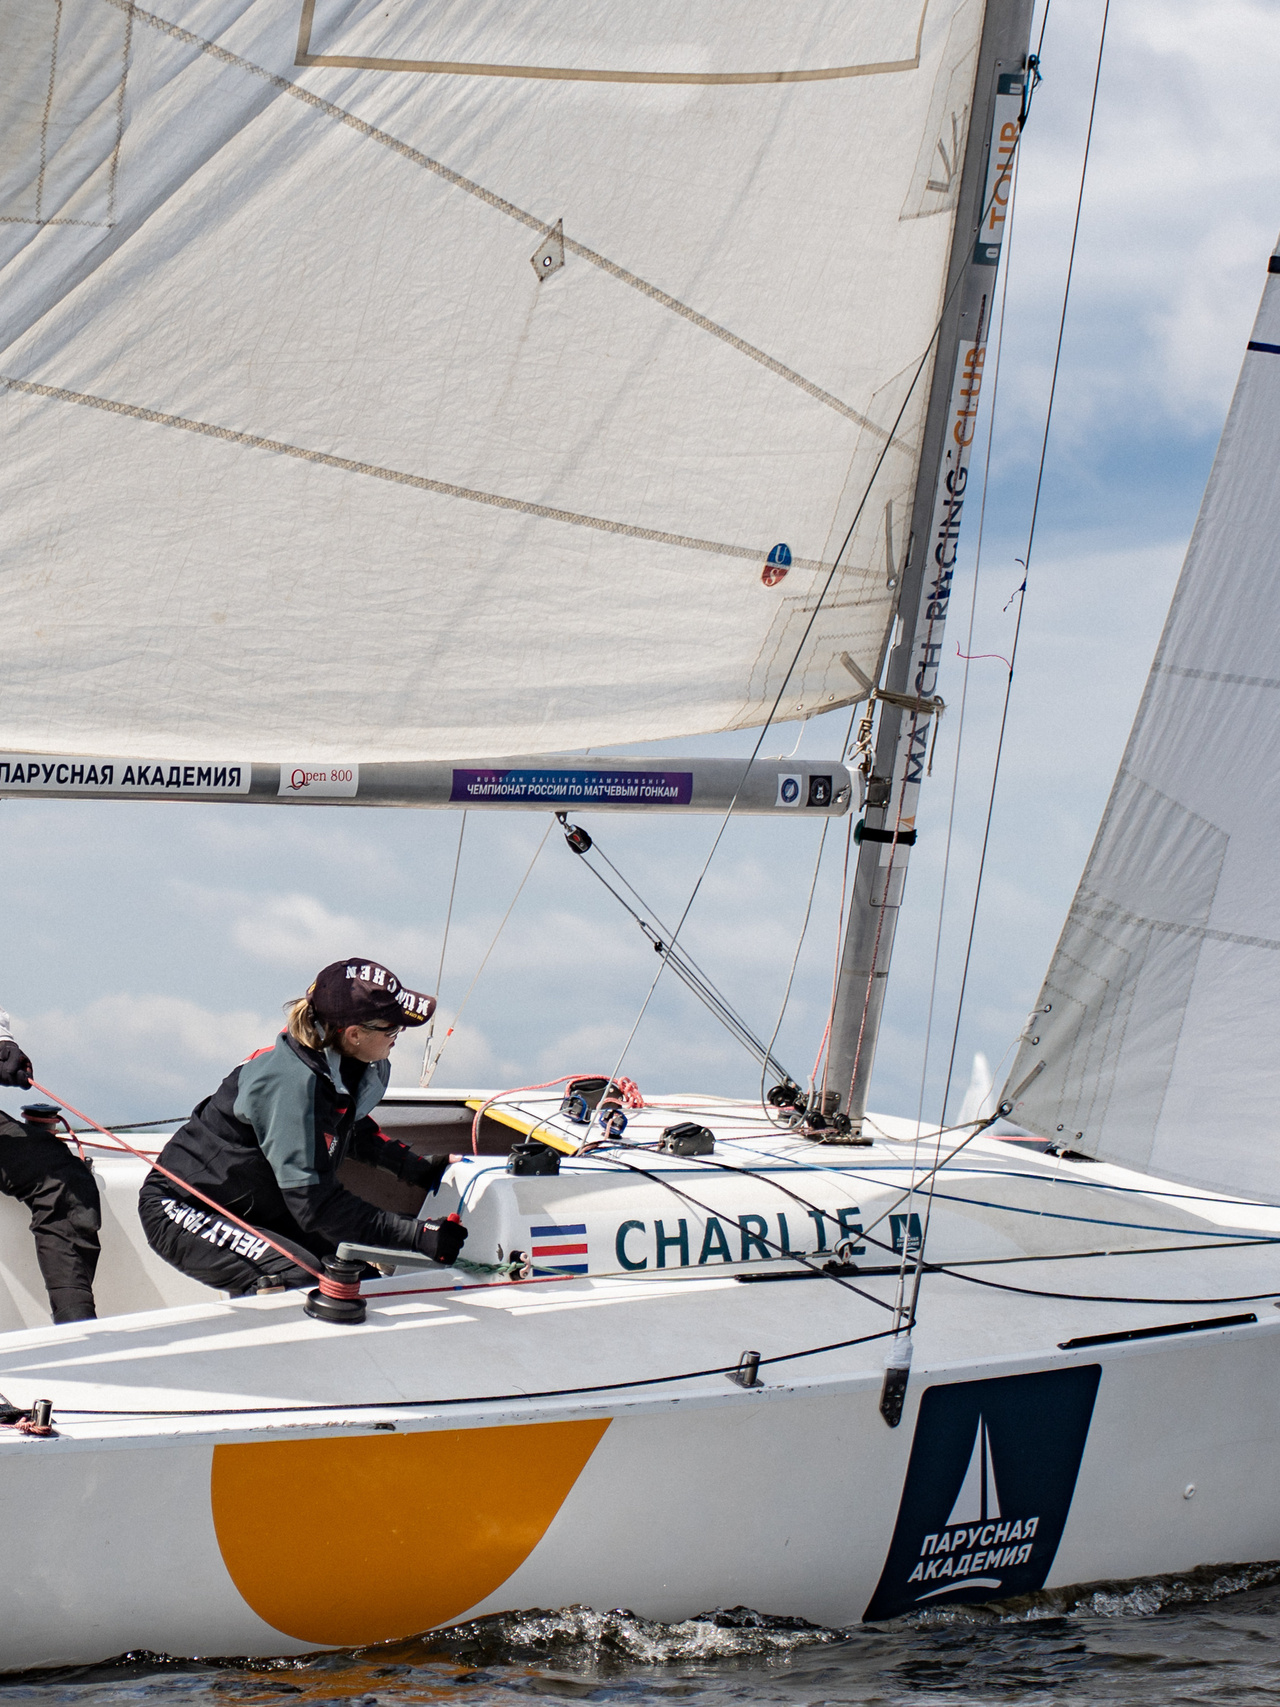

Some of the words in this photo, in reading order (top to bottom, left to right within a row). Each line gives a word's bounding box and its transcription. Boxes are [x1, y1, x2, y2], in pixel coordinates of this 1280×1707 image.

[925, 466, 968, 621] RACING
[953, 347, 986, 447] CLUB
[989, 122, 1019, 230] TOUR
[121, 765, 242, 789] АКАДЕМИЯ
[330, 769, 353, 783] 800
[467, 784, 527, 796] ЧЕМПИОНАТ
[527, 785, 567, 796] РОССИИ
[568, 785, 583, 796] ПО
[583, 786, 638, 797] МАТЧЕВЫМ
[639, 786, 679, 798] ГОНКАМ
[584, 777, 666, 785] CHAMPIONSHIP
[345, 964, 431, 1017] MUNCHEN
[200, 1220, 271, 1261] HELLY
[615, 1206, 867, 1271] CHARLIE
[920, 1516, 1040, 1557] ПАРУСНАЯ
[907, 1543, 1033, 1583] АКАДЕМИЯ
